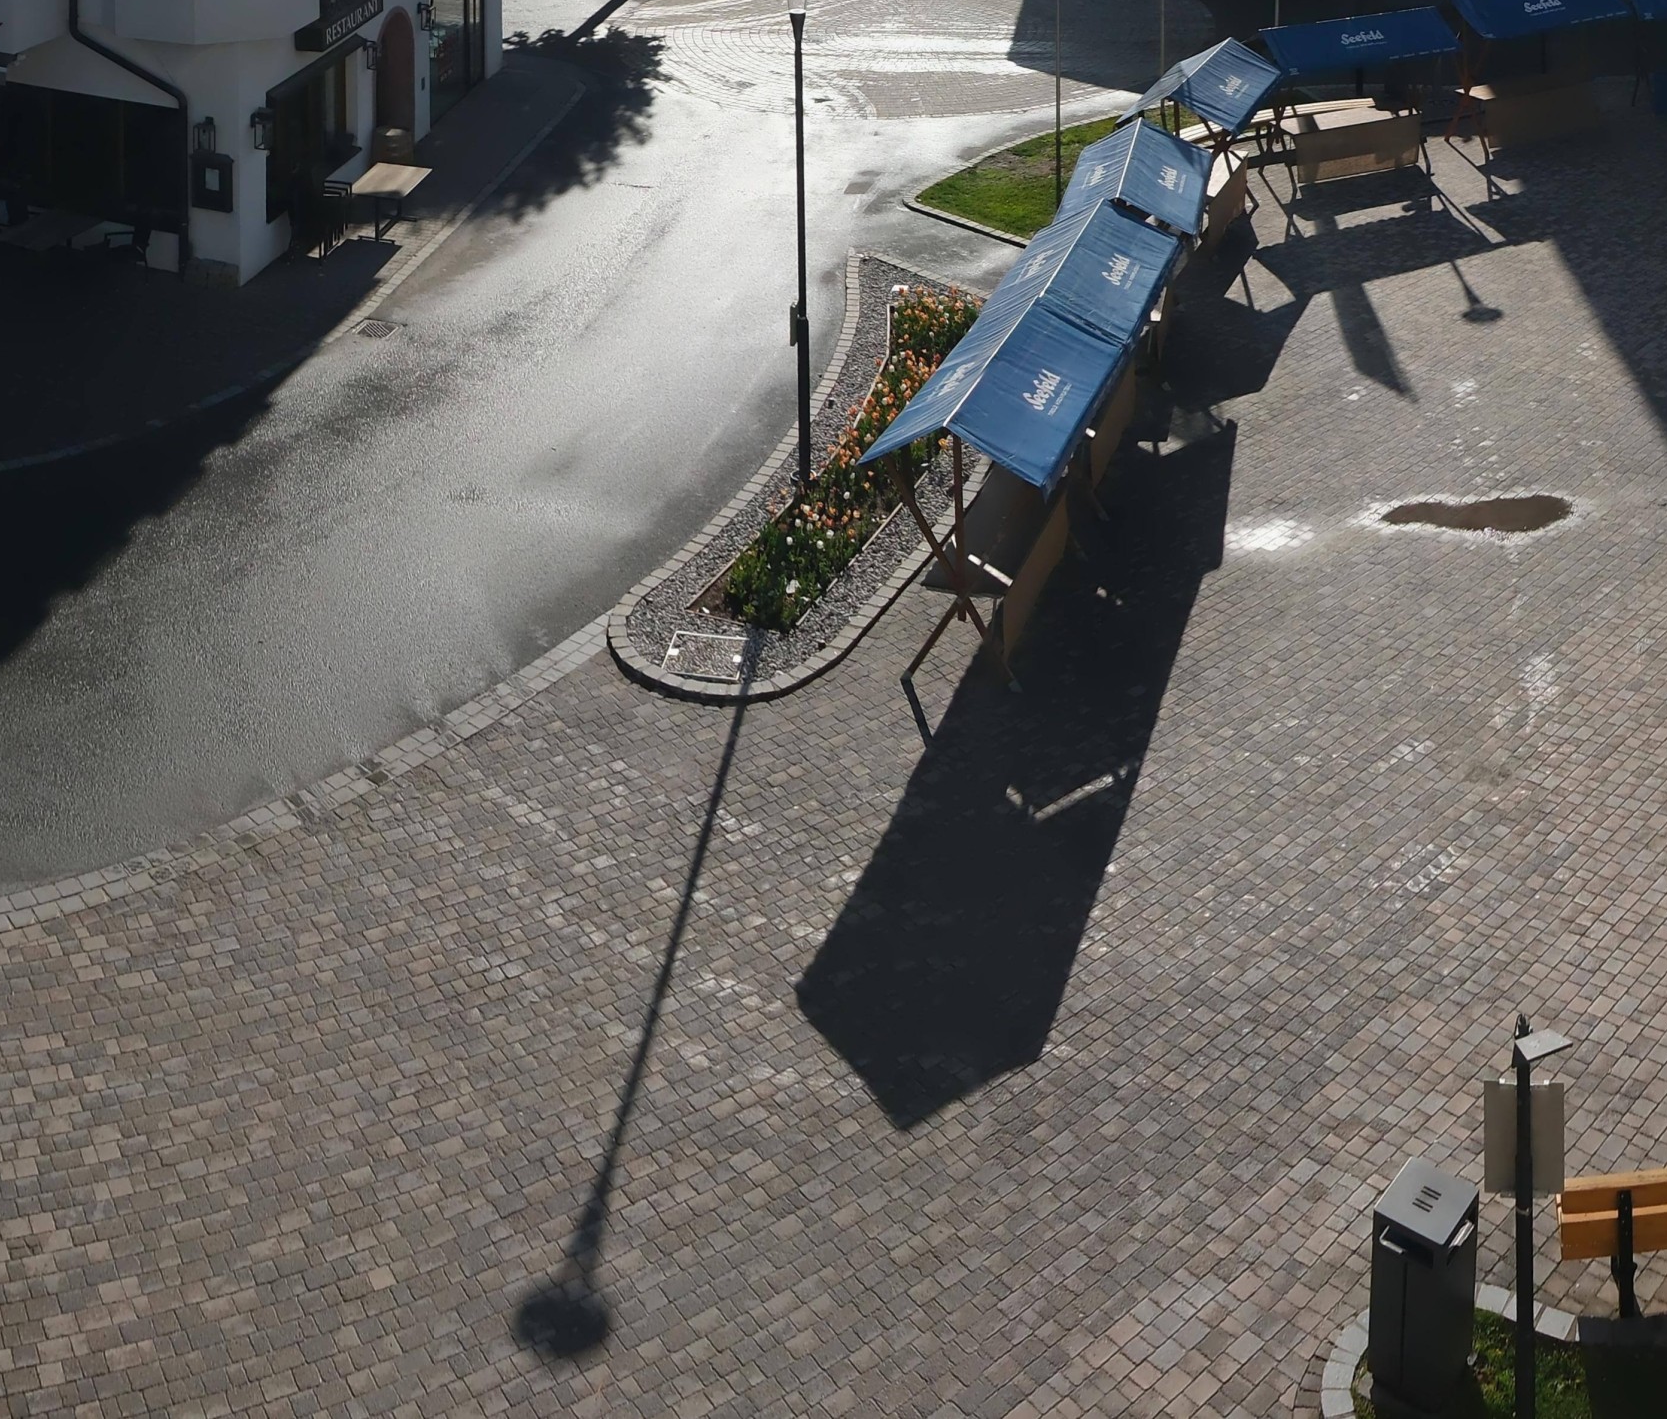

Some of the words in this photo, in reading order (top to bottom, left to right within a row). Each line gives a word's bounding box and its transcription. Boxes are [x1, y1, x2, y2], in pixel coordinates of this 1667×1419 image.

[1341, 29, 1384, 45] Seefeld
[1157, 165, 1178, 191] Seefeld
[1101, 252, 1131, 286] Seefeld
[1022, 368, 1061, 411] Seefeld
